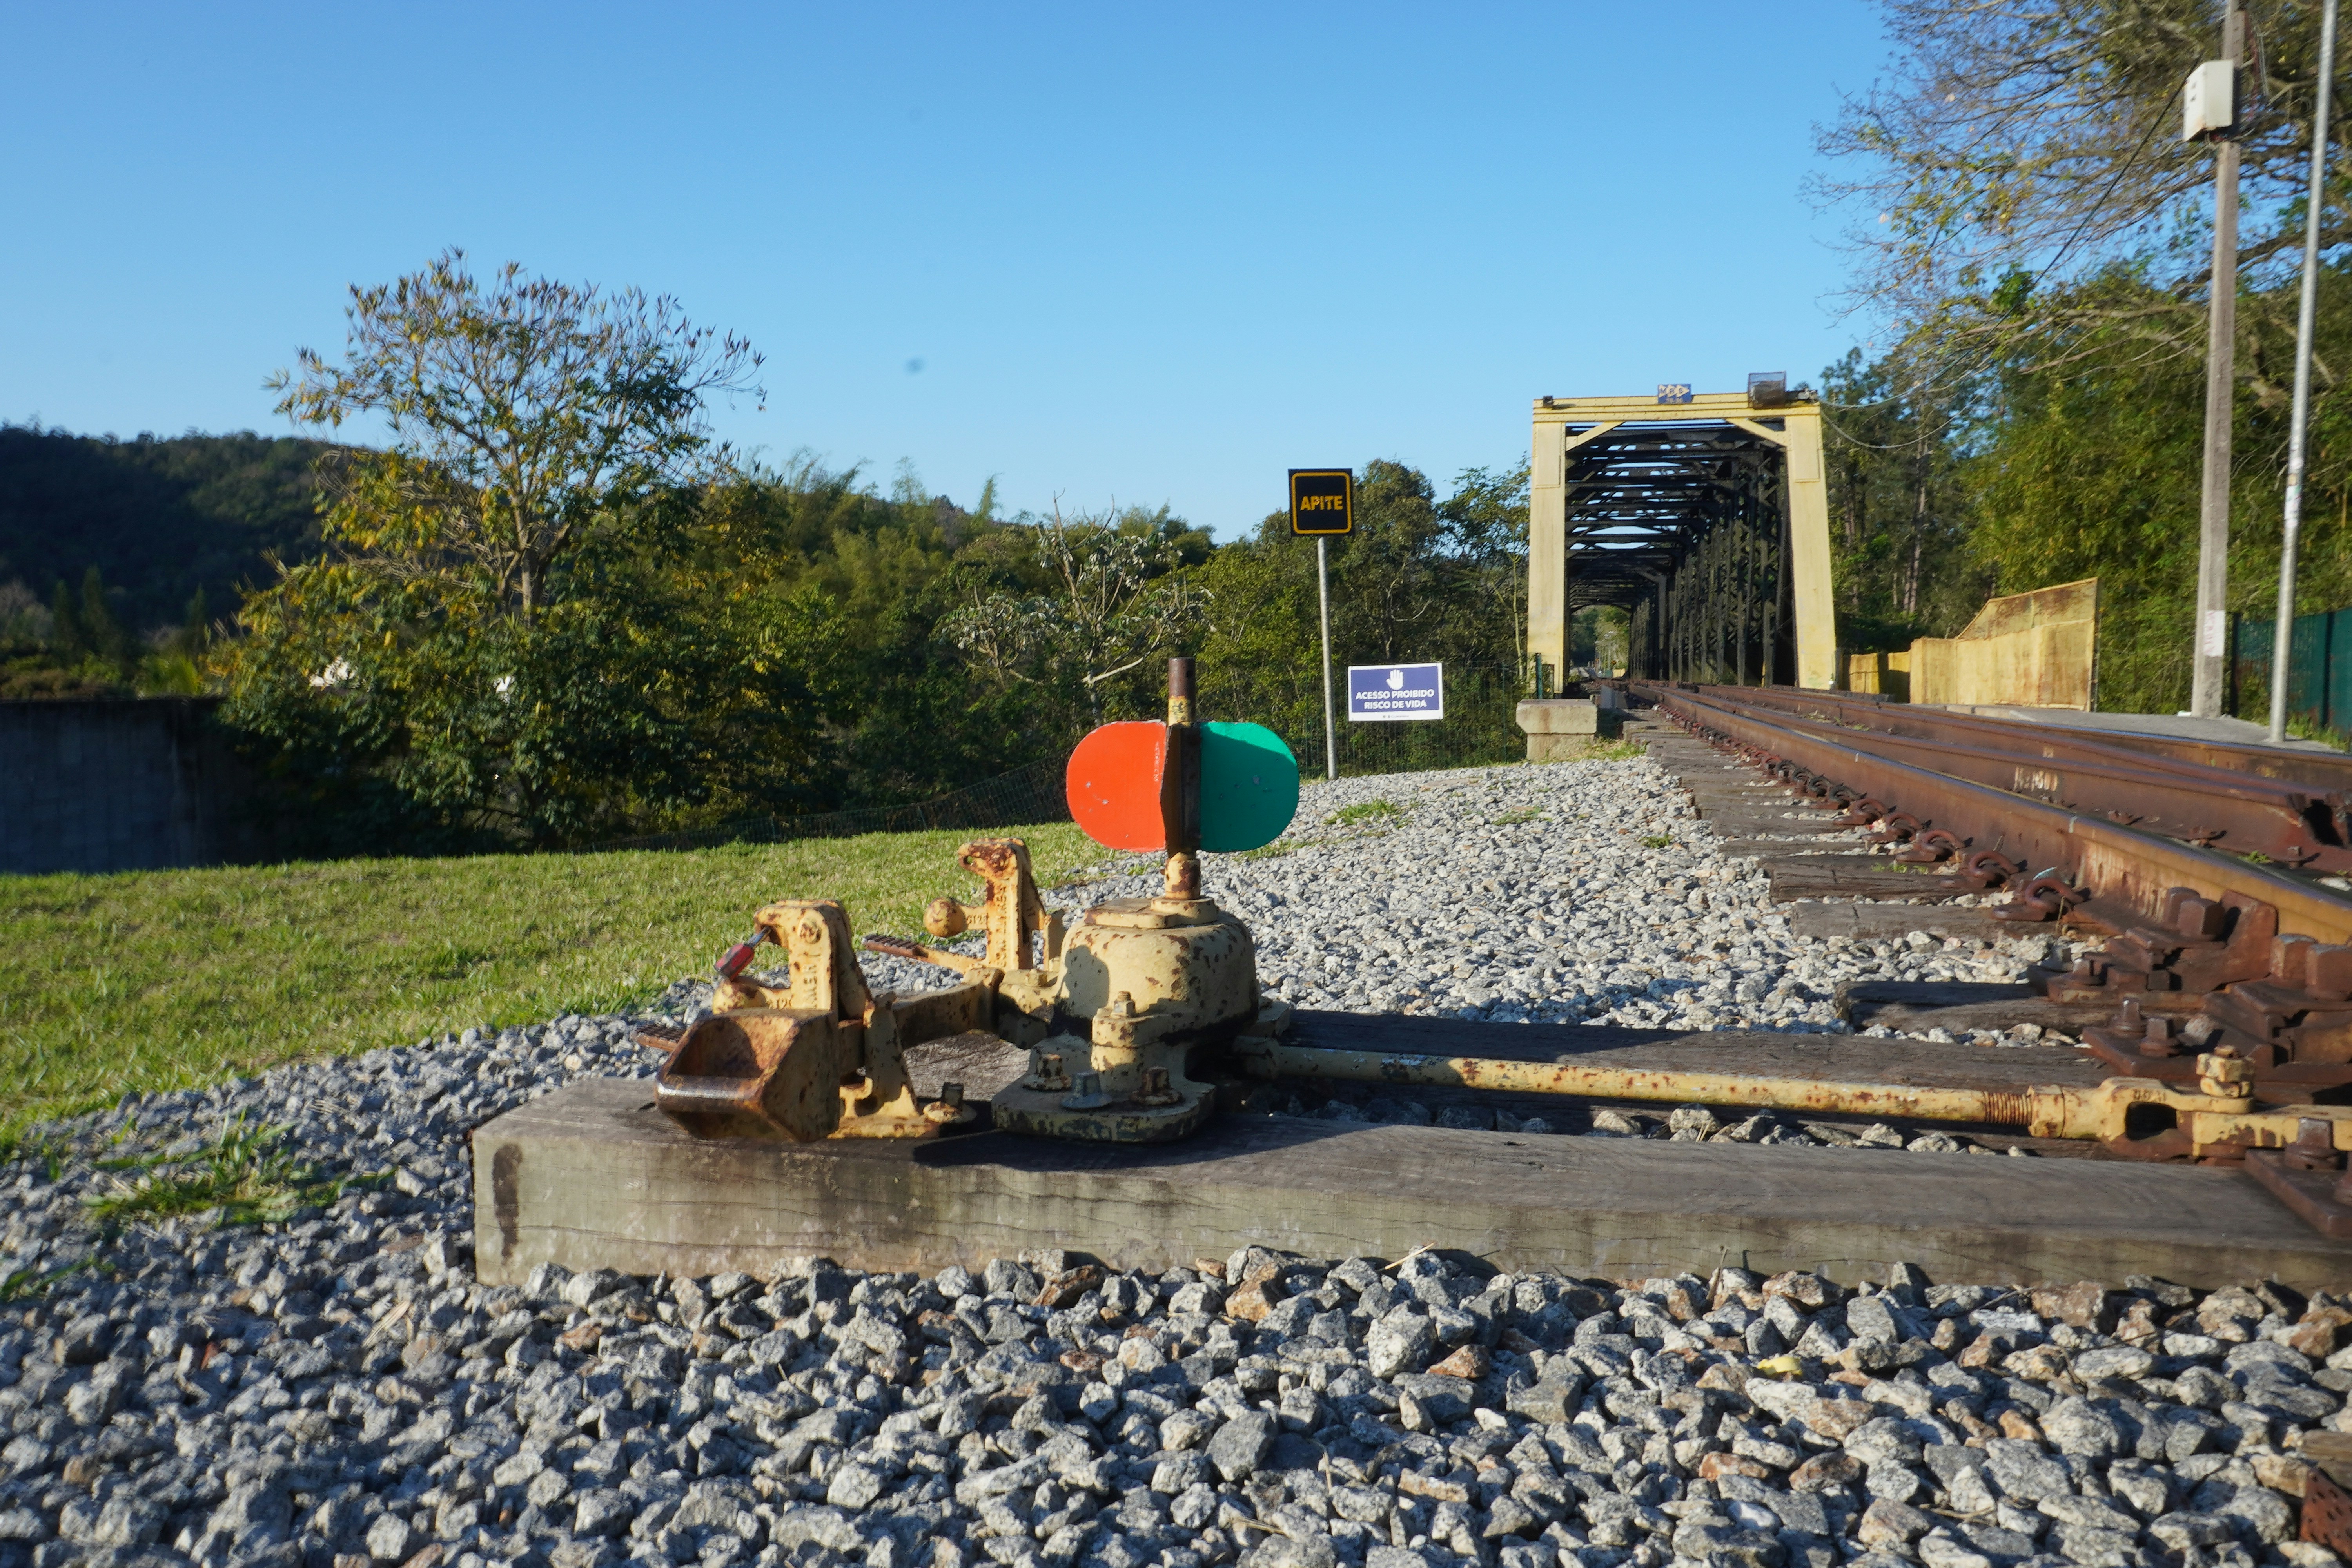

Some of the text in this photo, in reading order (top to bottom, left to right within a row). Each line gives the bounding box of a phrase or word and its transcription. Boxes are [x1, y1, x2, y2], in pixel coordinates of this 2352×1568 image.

[1300, 495, 1343, 510] APITE
[1355, 689, 1435, 700] ACESSO PROIBIDO
[1364, 699, 1427, 710] RISCO DE VIDA
